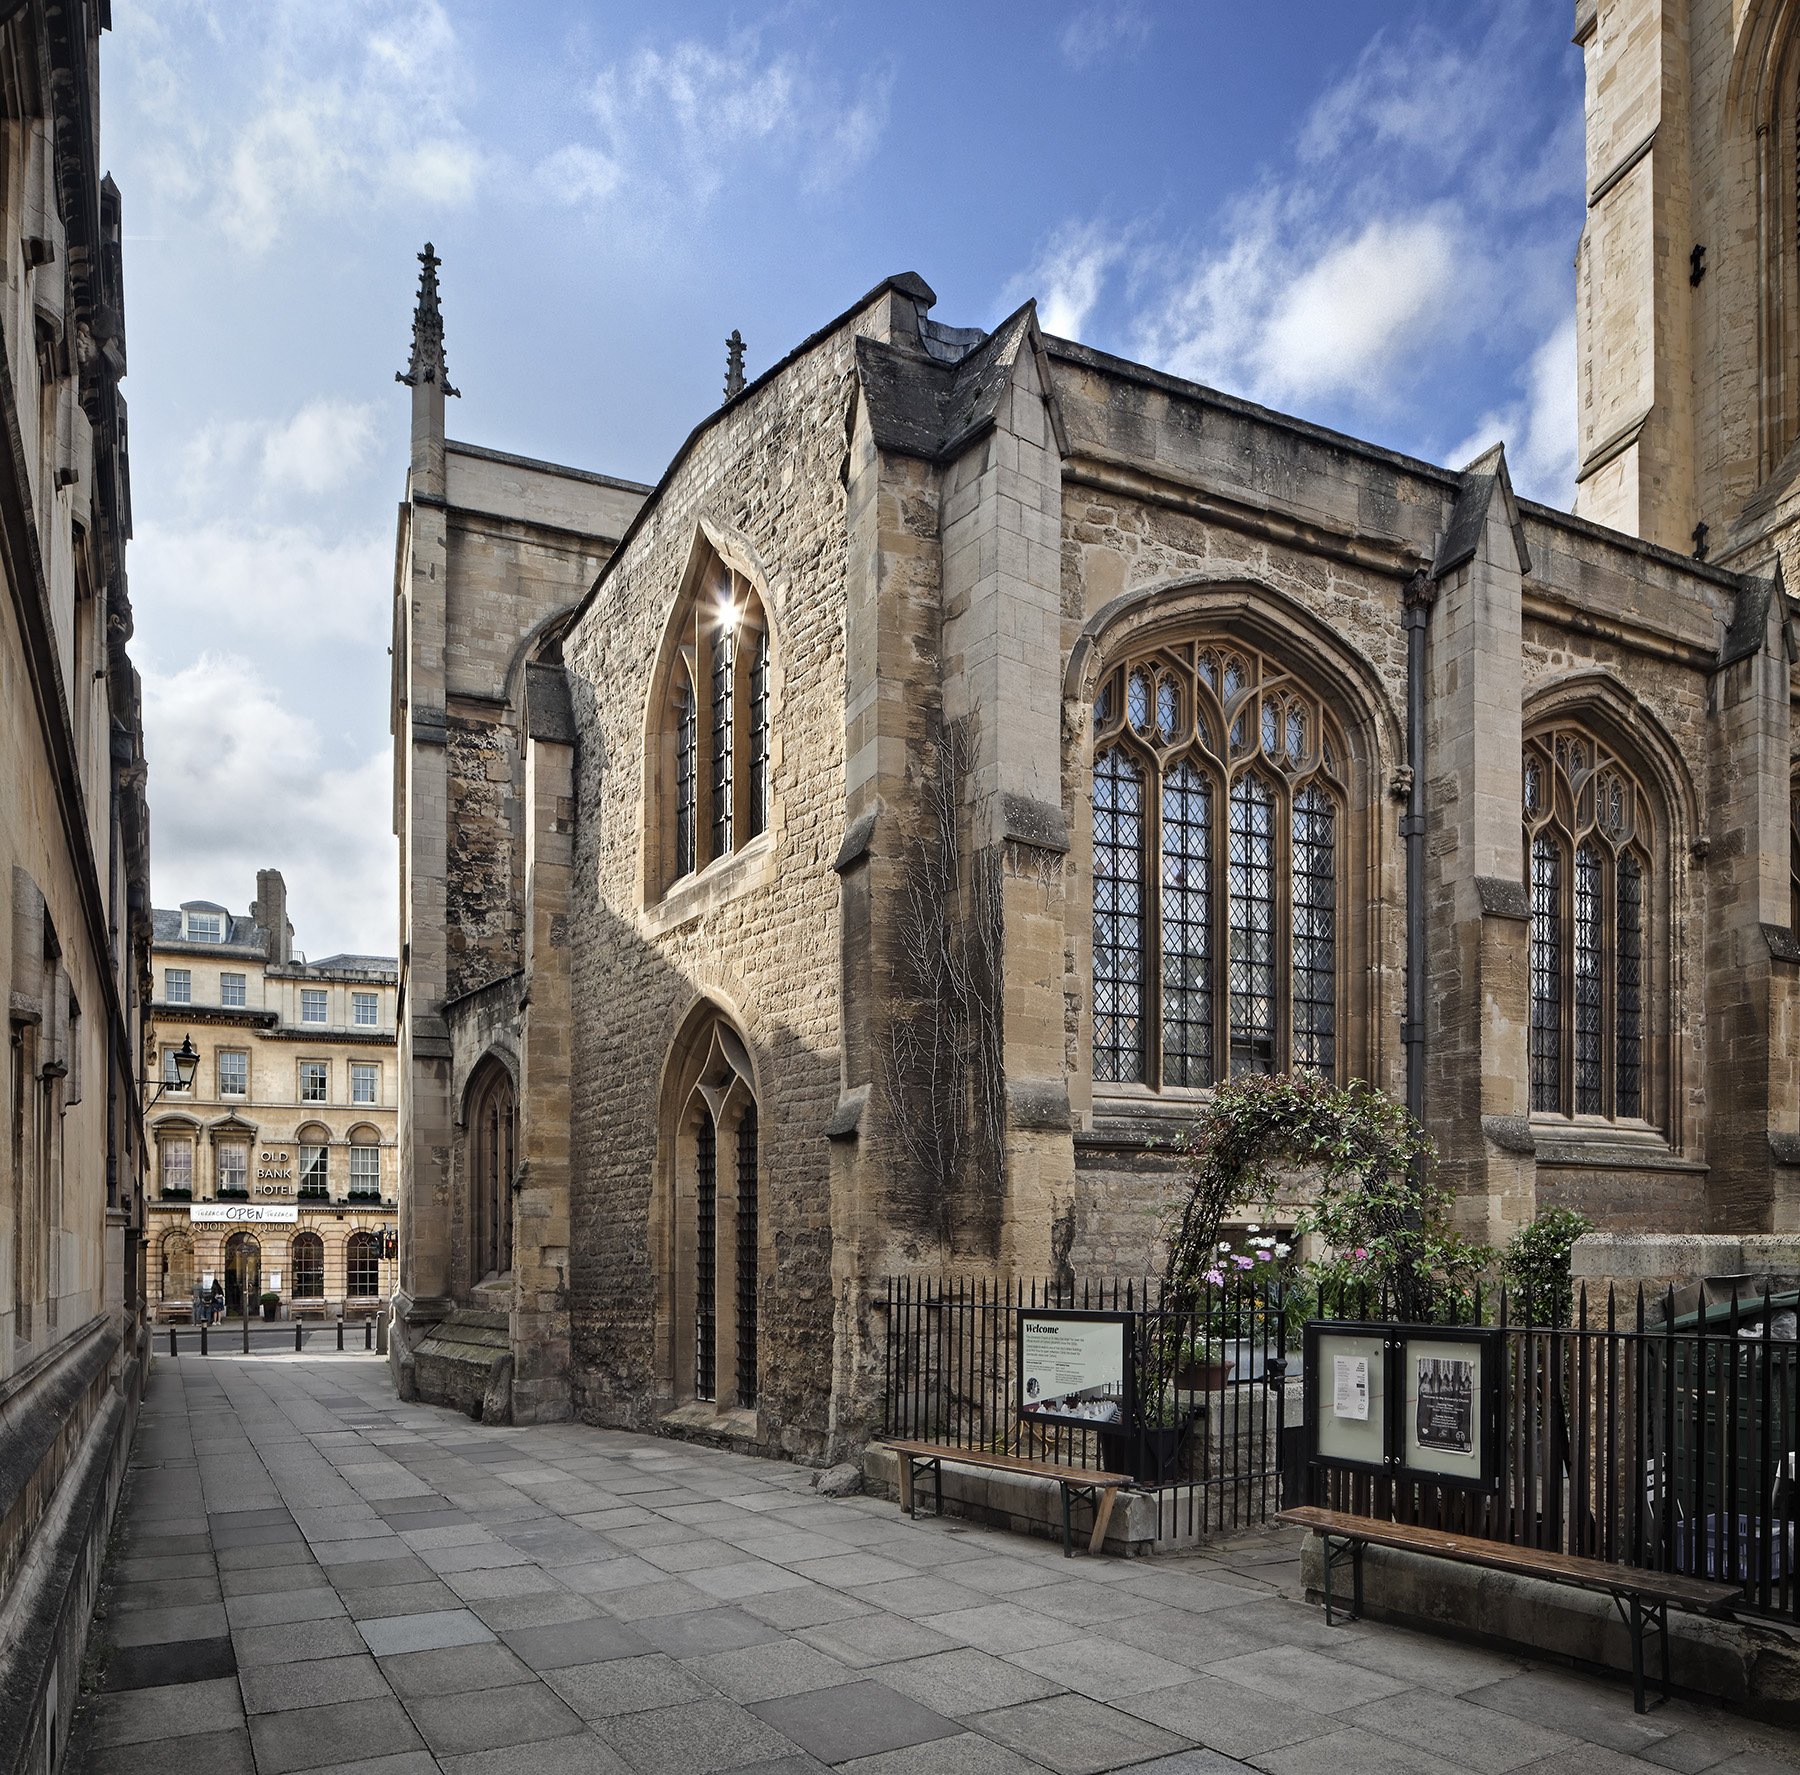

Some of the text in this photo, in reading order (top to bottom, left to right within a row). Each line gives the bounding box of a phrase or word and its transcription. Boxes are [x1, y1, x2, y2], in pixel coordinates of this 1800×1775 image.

[260, 1151, 289, 1162] OLD
[257, 1168, 292, 1179] BANK
[254, 1184, 296, 1196] HOTEL
[226, 1207, 264, 1220] OPEN
[192, 1223, 226, 1233] QUOD
[258, 1223, 292, 1233] QUOD
[1026, 1324, 1060, 1334] Welcome
